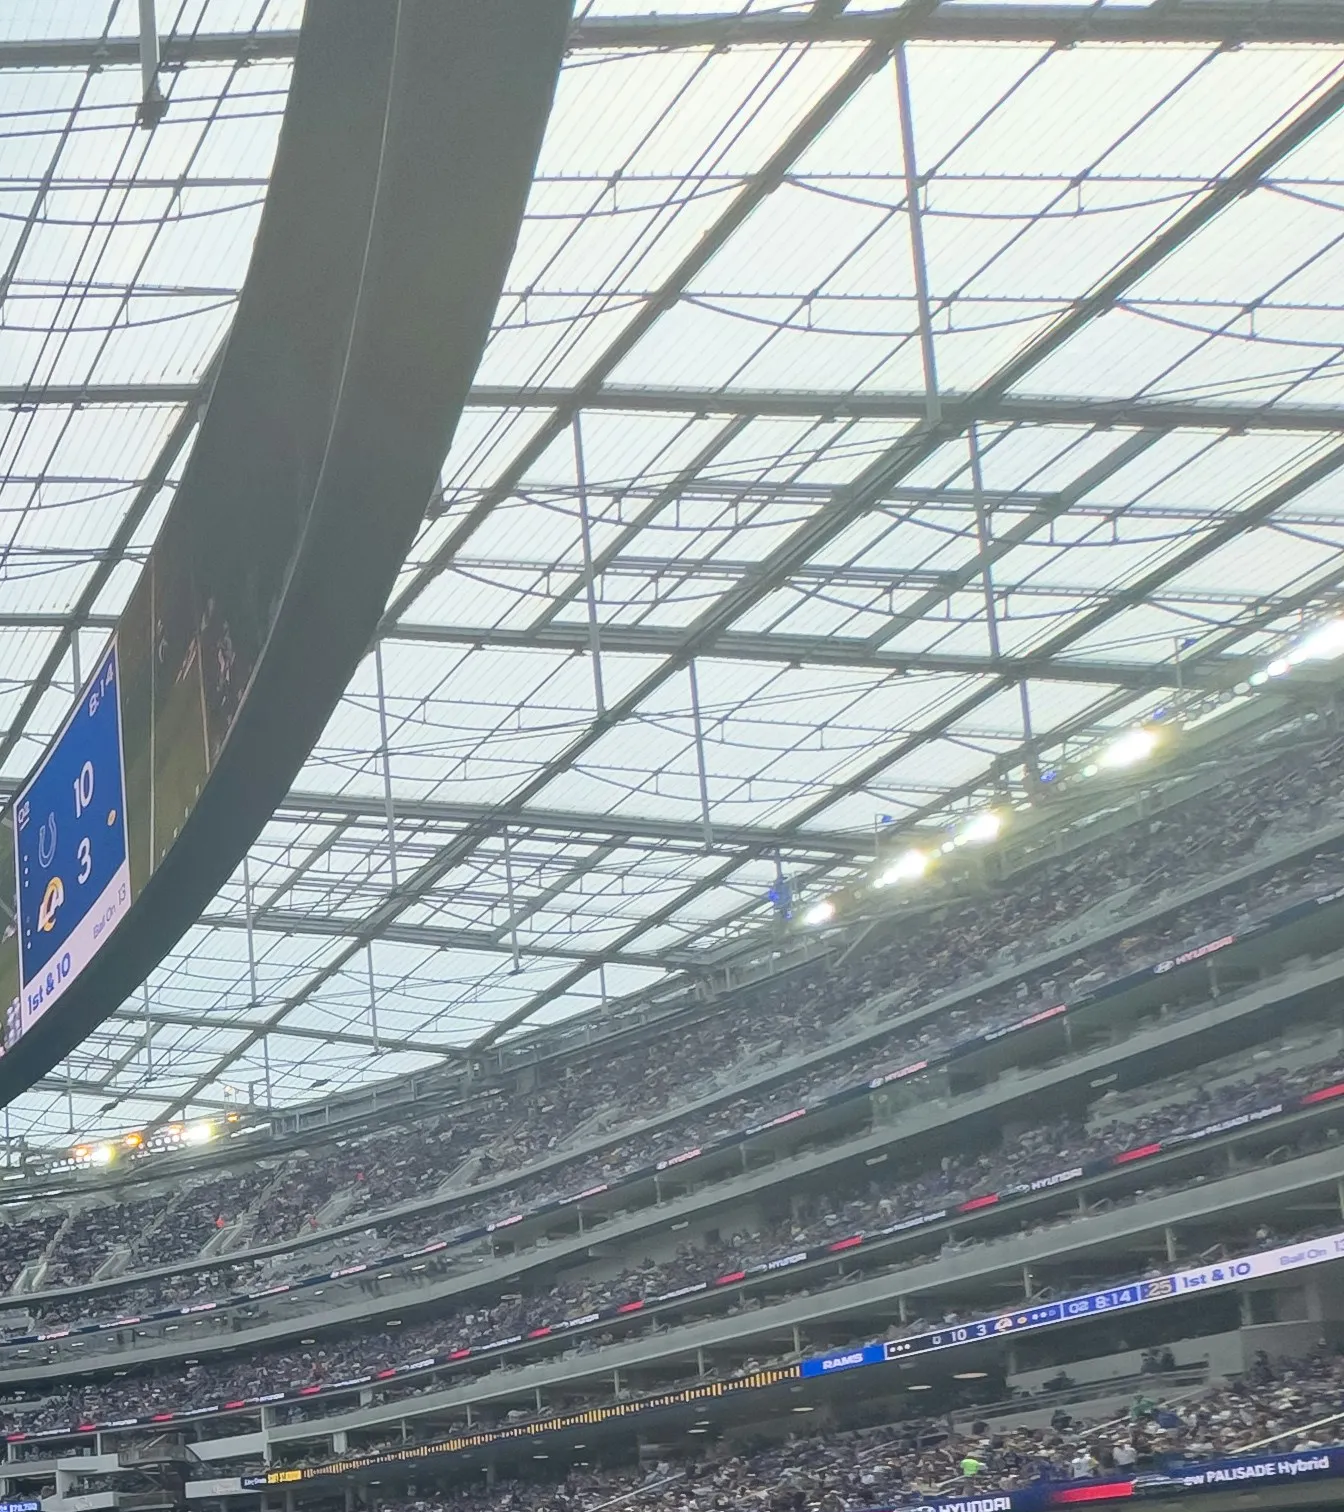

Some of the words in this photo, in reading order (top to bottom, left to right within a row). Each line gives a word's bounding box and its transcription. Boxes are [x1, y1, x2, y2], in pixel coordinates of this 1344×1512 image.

[73, 759, 95, 819] 10
[76, 835, 92, 885] 3
[27, 985, 44, 1017] 1st
[44, 975, 55, 996] &
[55, 951, 72, 986] 10
[1182, 1274, 1208, 1288] 1st
[1212, 1269, 1225, 1281] &
[1229, 1263, 1251, 1276] 10
[1095, 1290, 1132, 1309] 8:14
[1148, 1283, 1172, 1296] 25
[952, 1329, 967, 1341] 10
[976, 1325, 987, 1336] 3
[822, 1353, 864, 1370] RAMS
[1206, 1464, 1276, 1483] PALISADE
[1278, 1456, 1330, 1475] Hybrid
